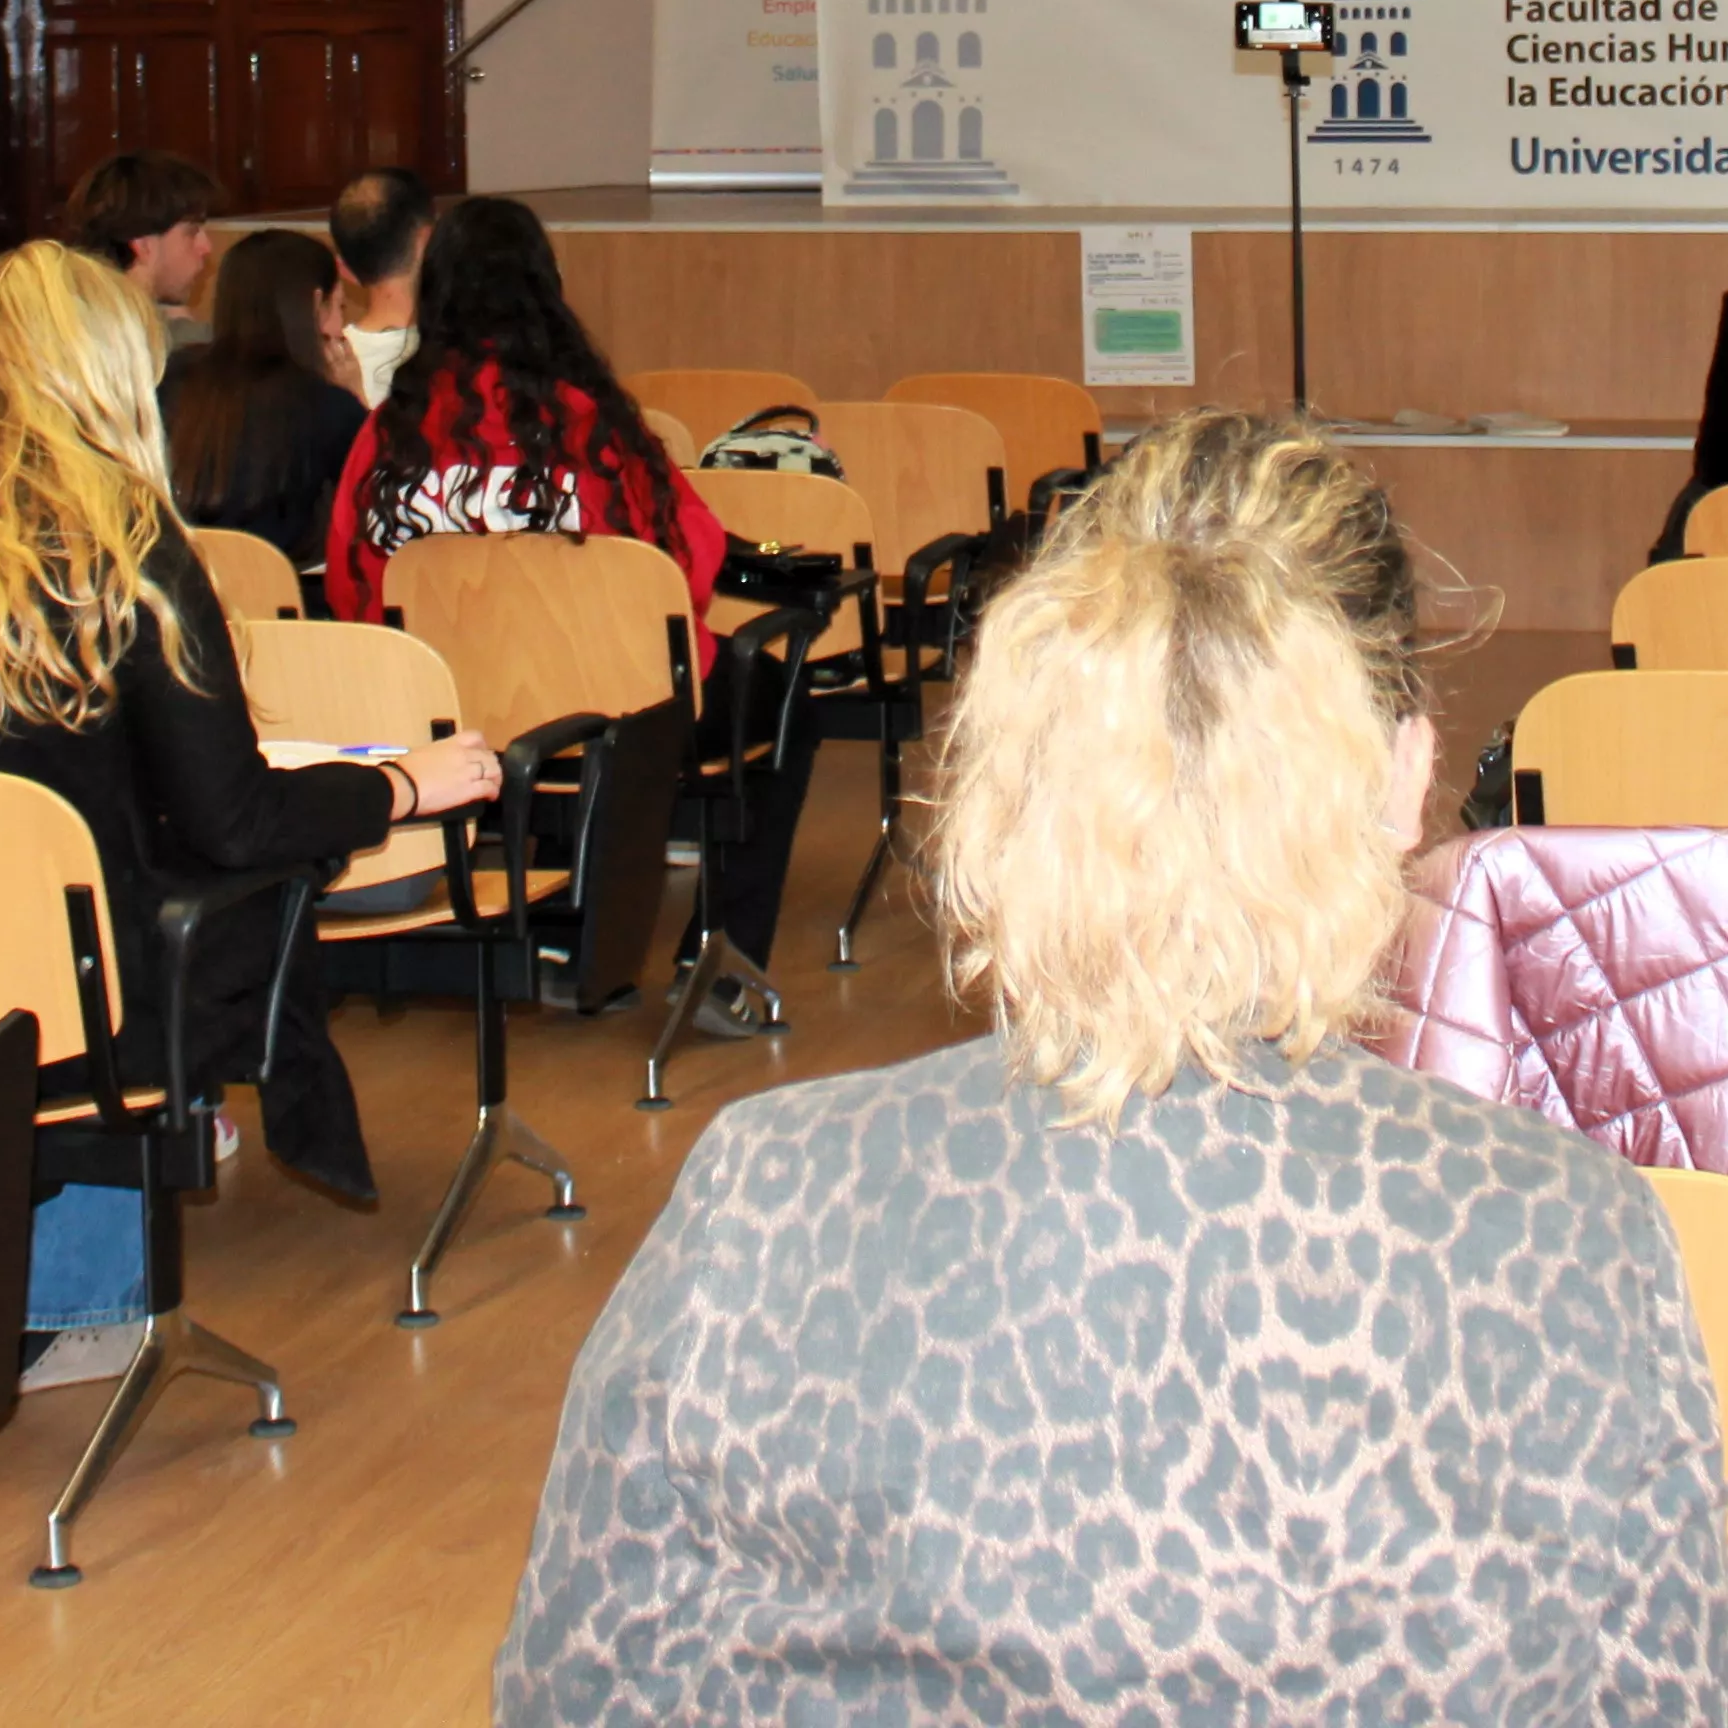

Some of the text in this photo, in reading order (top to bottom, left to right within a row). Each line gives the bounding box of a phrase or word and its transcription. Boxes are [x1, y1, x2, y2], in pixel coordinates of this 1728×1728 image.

[1507, 33, 1656, 64] Ciencias
[1508, 76, 1537, 107] la
[1333, 157, 1400, 176] 1474
